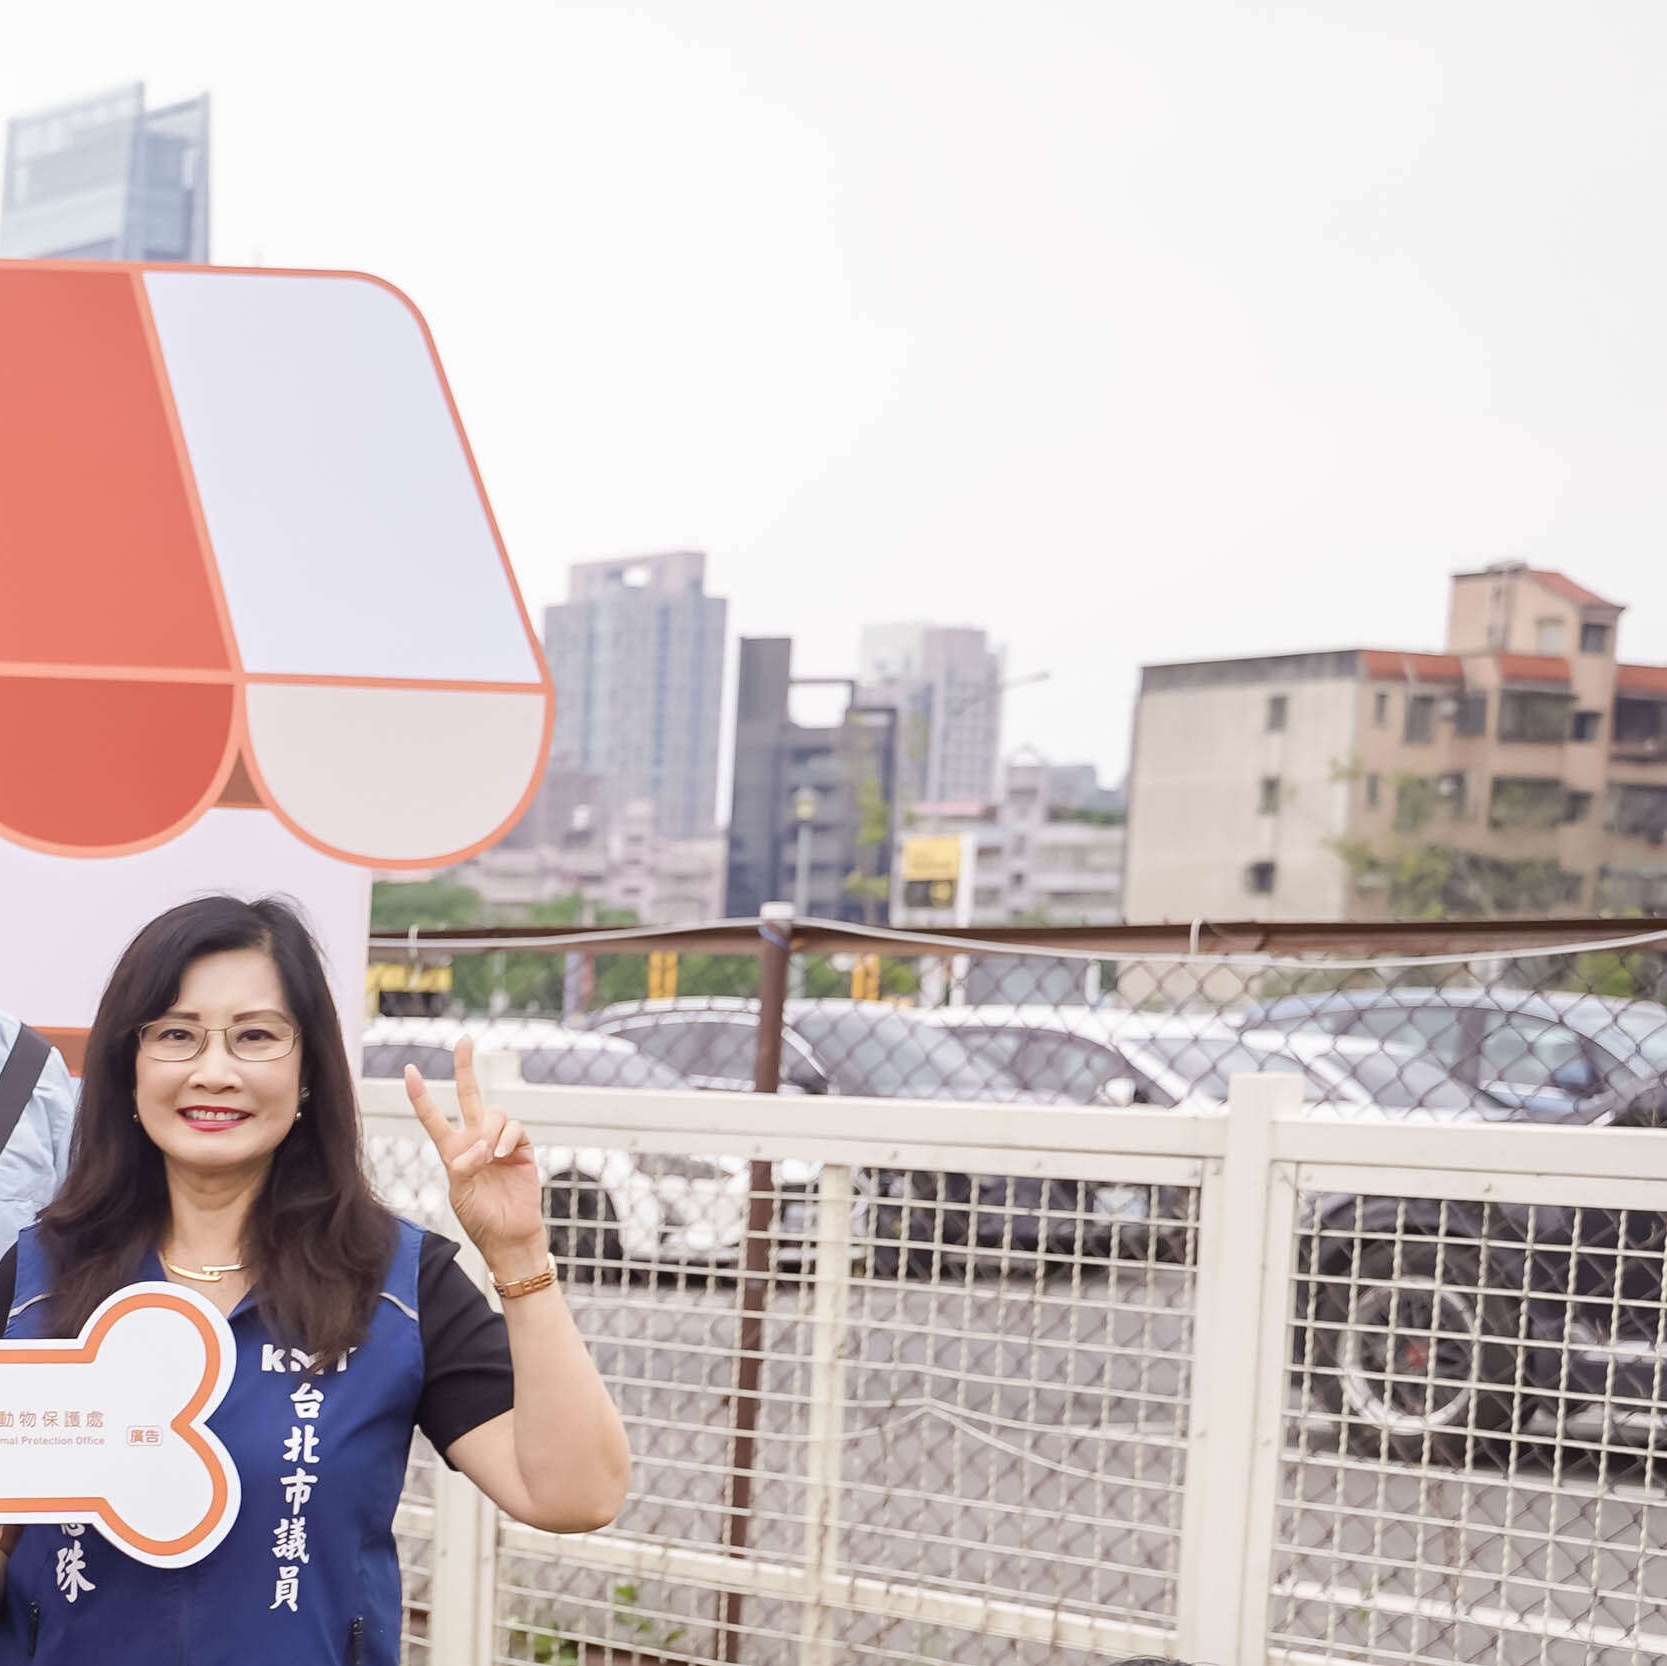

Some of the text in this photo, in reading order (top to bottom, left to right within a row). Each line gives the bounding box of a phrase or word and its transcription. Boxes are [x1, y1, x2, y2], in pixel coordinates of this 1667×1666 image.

[21, 1435, 73, 1446] Protection
[75, 1435, 105, 1446] Office
[130, 1429, 159, 1443] 廣告
[269, 1382, 325, 1613] 台北市議員
